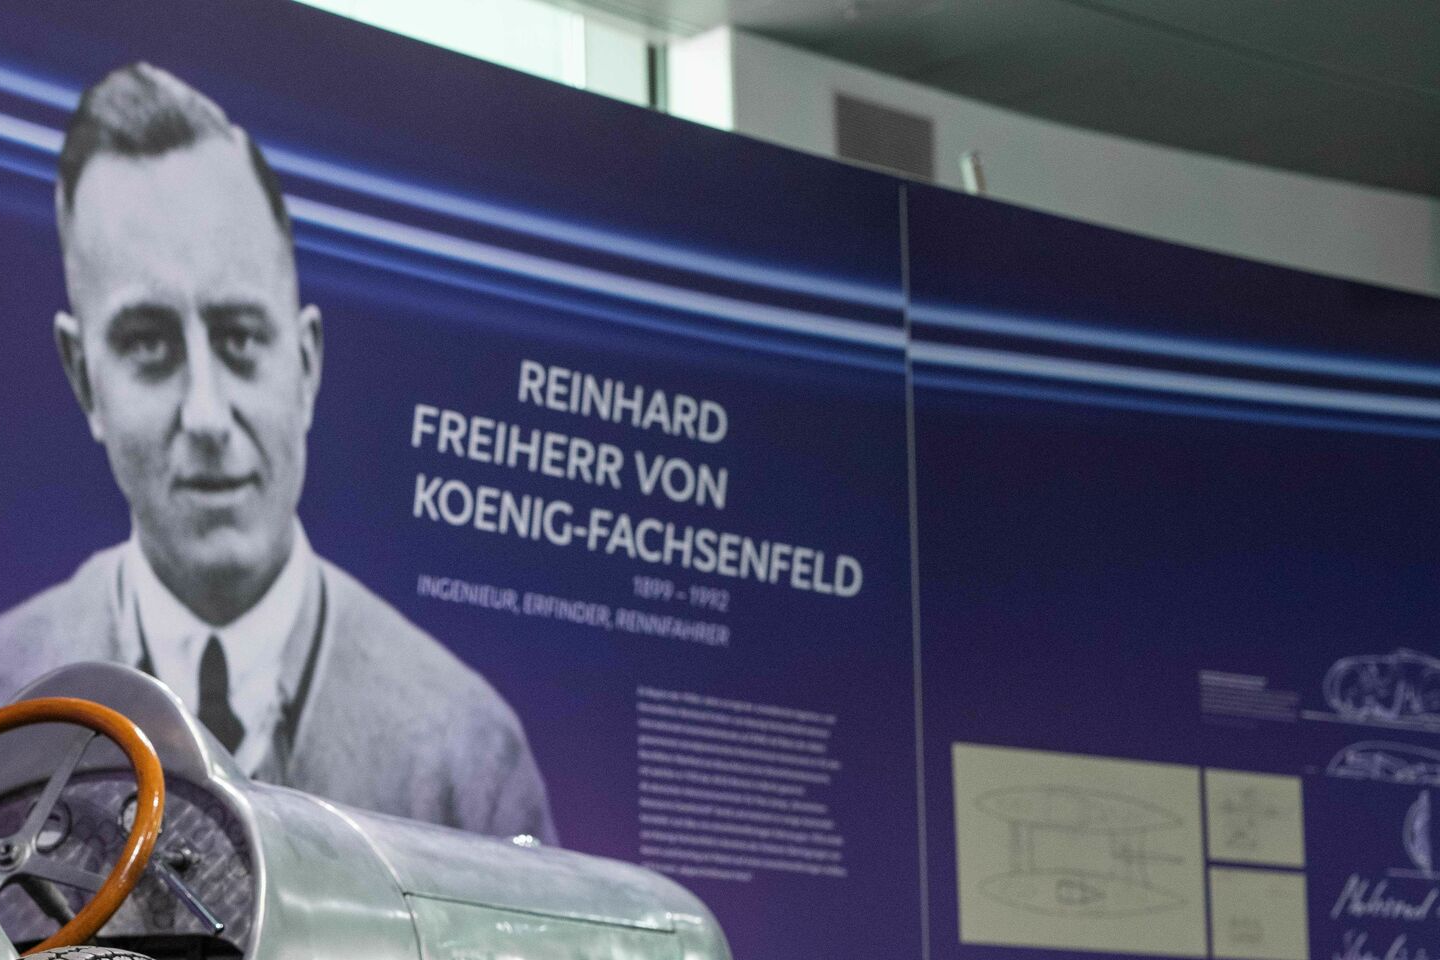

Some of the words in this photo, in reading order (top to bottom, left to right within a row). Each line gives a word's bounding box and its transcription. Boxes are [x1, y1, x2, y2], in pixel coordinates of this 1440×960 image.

[518, 359, 728, 444] REINHARD
[411, 404, 624, 489] FREIHERR
[634, 450, 728, 510] VON
[412, 473, 863, 598] KOENIG-FACHSENFELD
[417, 573, 520, 615] INGENIEUR,
[522, 592, 613, 632] ERFINDER,
[615, 607, 730, 647] RENNFAHRER
